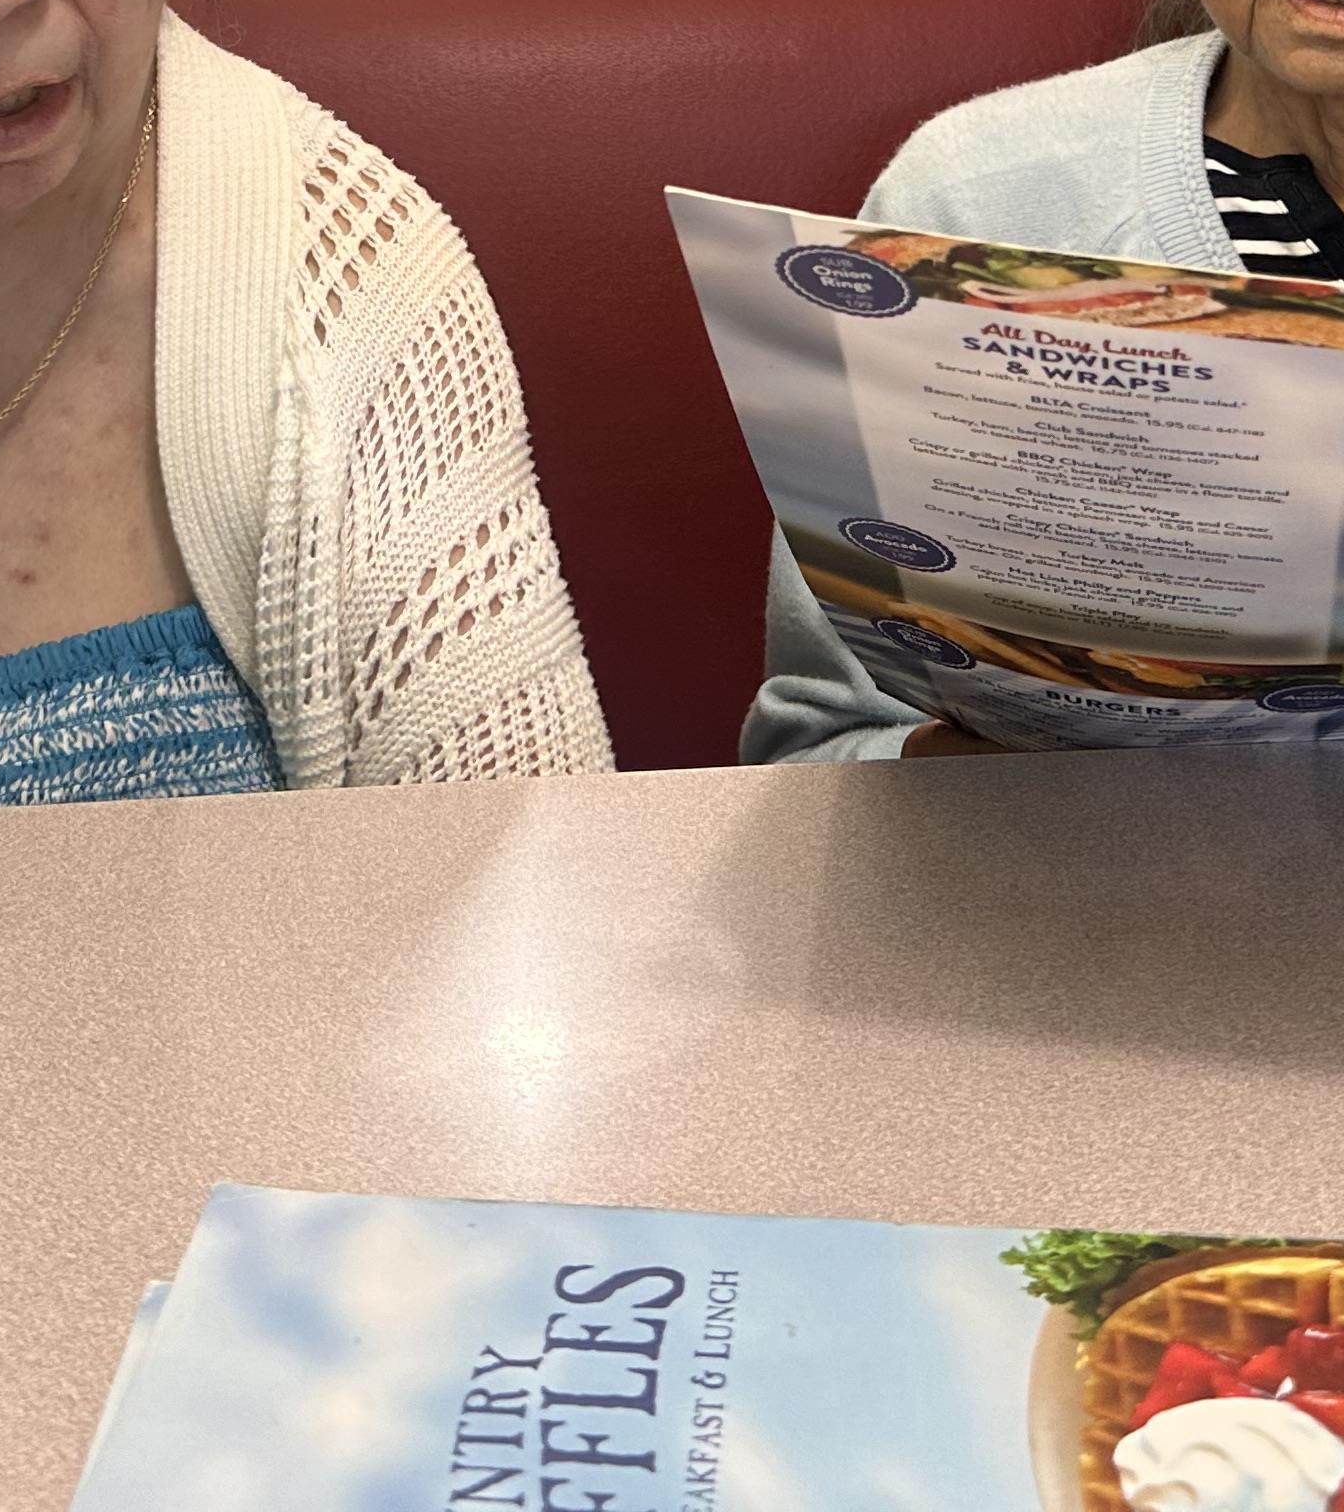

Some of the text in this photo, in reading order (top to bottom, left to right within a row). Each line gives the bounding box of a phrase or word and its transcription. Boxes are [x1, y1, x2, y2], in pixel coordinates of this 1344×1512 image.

[812, 265, 873, 280] Onion
[819, 276, 873, 293] Rings
[980, 323, 1192, 361] All Day Lunch
[962, 336, 1213, 381] SANDWICHES
[935, 362, 1199, 406] Served with house potato
[1006, 361, 1171, 393] & WRAPS
[924, 386, 1022, 409] Bacon, lettuce,
[1031, 396, 1151, 418] BLTA Croissant
[931, 411, 1259, 461] Turkey, lettuce and tomatoes stacked
[991, 430, 1037, 443] toasted
[1034, 422, 1150, 443] Club Sandwich
[908, 437, 949, 452] Crispy
[969, 451, 1007, 462] grilled
[1071, 466, 1113, 479] bacon,
[1117, 474, 1142, 482] jack
[1151, 478, 1196, 488] cheese,
[1200, 482, 1261, 495] tomatoes
[1265, 489, 1290, 497] and
[913, 446, 956, 459] lettuce
[960, 456, 997, 467] mixed
[1001, 463, 1028, 473] with
[1031, 469, 1067, 479] ranch
[1071, 475, 1094, 483] and
[1099, 479, 1131, 488] BBQ
[1136, 484, 1171, 493] sauce
[1203, 491, 1234, 499] flour
[1018, 451, 1172, 479] BBQ Wrap
[933, 478, 974, 491] Grilled
[978, 489, 1030, 503] chicken,
[1032, 498, 1080, 511] lettuce,
[1083, 505, 1146, 521] Parmesan
[1150, 516, 1193, 525] cheese
[1224, 522, 1269, 533] Caesar
[987, 496, 1114, 522] wrapped spinach
[1016, 487, 1180, 517] Chicken Wrap
[864, 534, 928, 553] Avocado
[924, 503, 945, 513] On
[958, 511, 1000, 523] French
[1238, 554, 1283, 563] tomato
[978, 523, 1040, 540] and honey
[1007, 513, 1194, 547] Crispy Sandwich
[946, 535, 1265, 588] Turkey and American
[1058, 550, 1106, 564] Turkey
[969, 564, 1005, 578] Cajun
[1179, 601, 1218, 611] onions
[977, 574, 1095, 600] peppers French
[1008, 566, 1035, 577] Hot
[1039, 573, 1068, 583] Link
[1073, 578, 1112, 592] Philly
[1145, 589, 1201, 602] Peppers
[1070, 603, 1142, 621] Triple Play
[1045, 689, 1183, 718] BURGERS
[693, 1269, 740, 1360] LUNCH
[690, 1370, 727, 1389] &
[446, 1345, 544, 1512] NTRY
